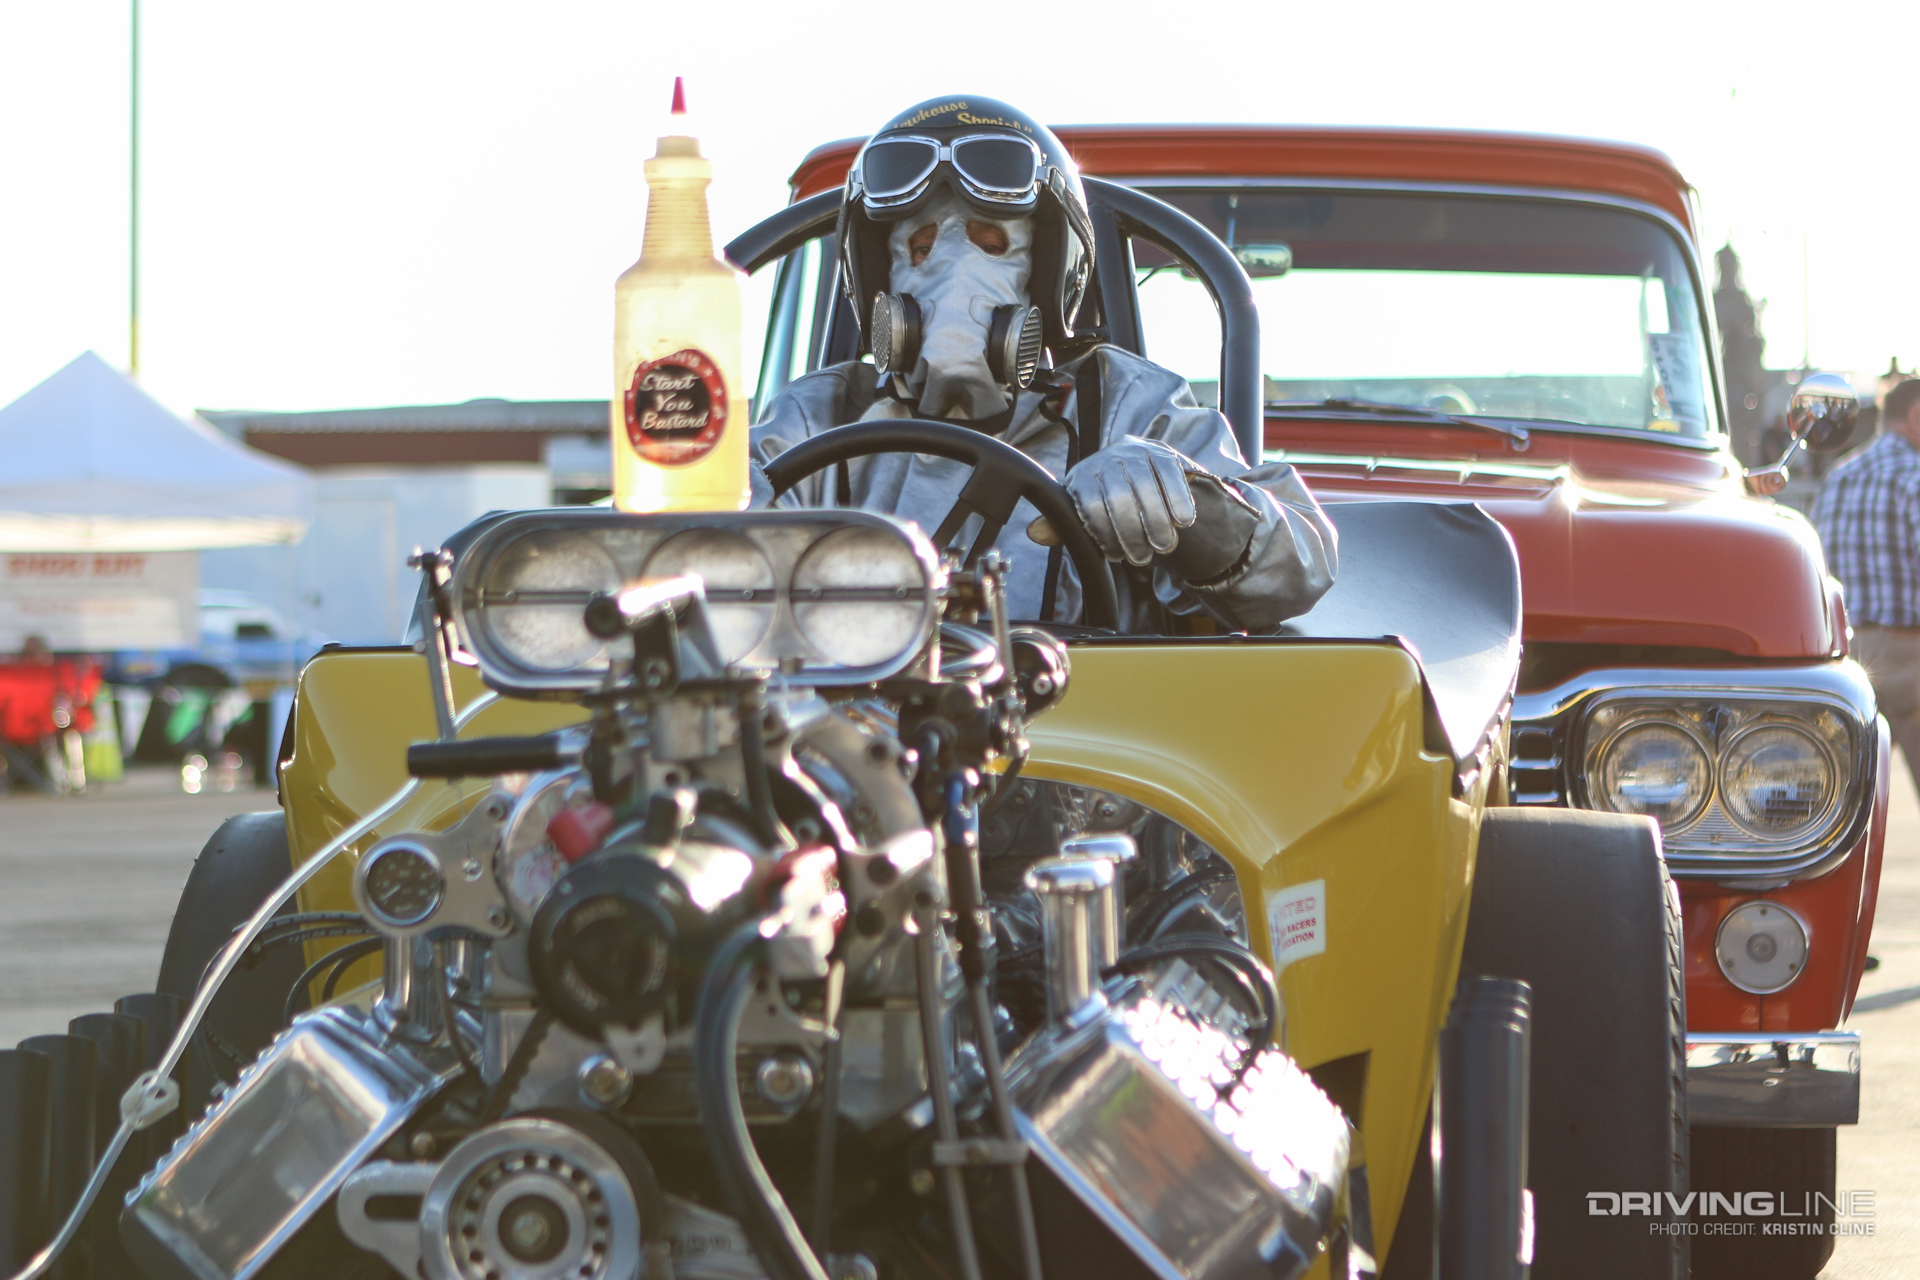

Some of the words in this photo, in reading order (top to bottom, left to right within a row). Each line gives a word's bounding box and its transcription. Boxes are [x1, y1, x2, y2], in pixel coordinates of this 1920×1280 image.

[639, 373, 700, 392] Start
[654, 393, 695, 412] You
[640, 410, 709, 431] Bastard
[1287, 918, 1317, 934] RACERS
